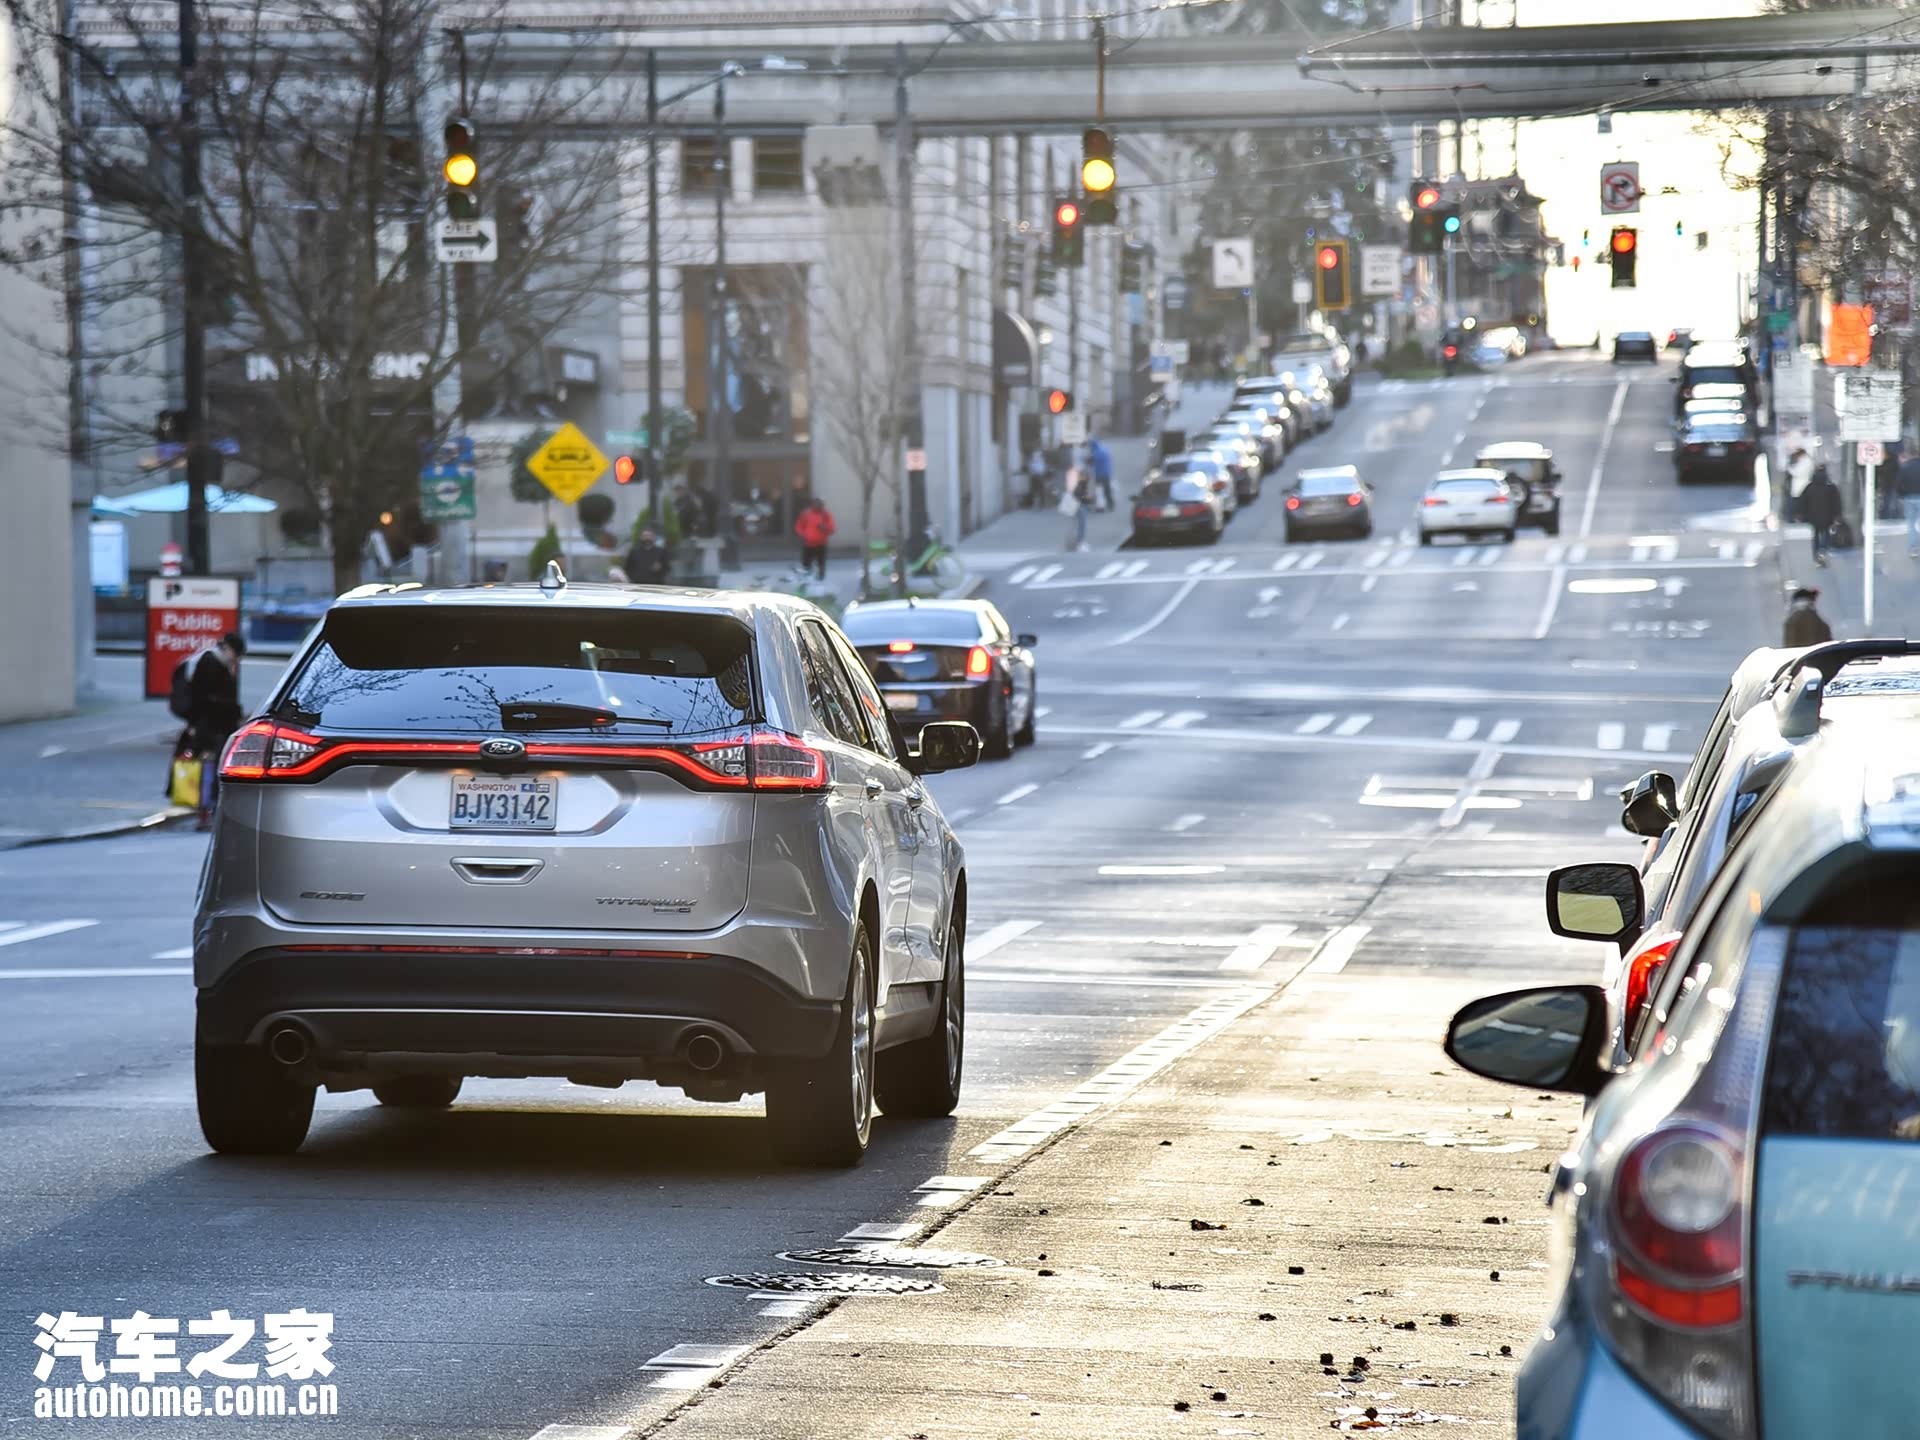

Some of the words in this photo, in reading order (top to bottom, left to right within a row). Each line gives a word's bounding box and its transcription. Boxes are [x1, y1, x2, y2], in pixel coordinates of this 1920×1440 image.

[444, 223, 473, 234] ONE
[447, 249, 474, 258] WAY
[162, 613, 222, 631] Public
[156, 634, 218, 651] Parkin
[488, 742, 516, 753] Ford
[458, 783, 516, 791] WASHINGTON
[454, 793, 550, 820] BJY3142
[299, 891, 367, 901] EDGE
[595, 897, 698, 906] TITANIUM
